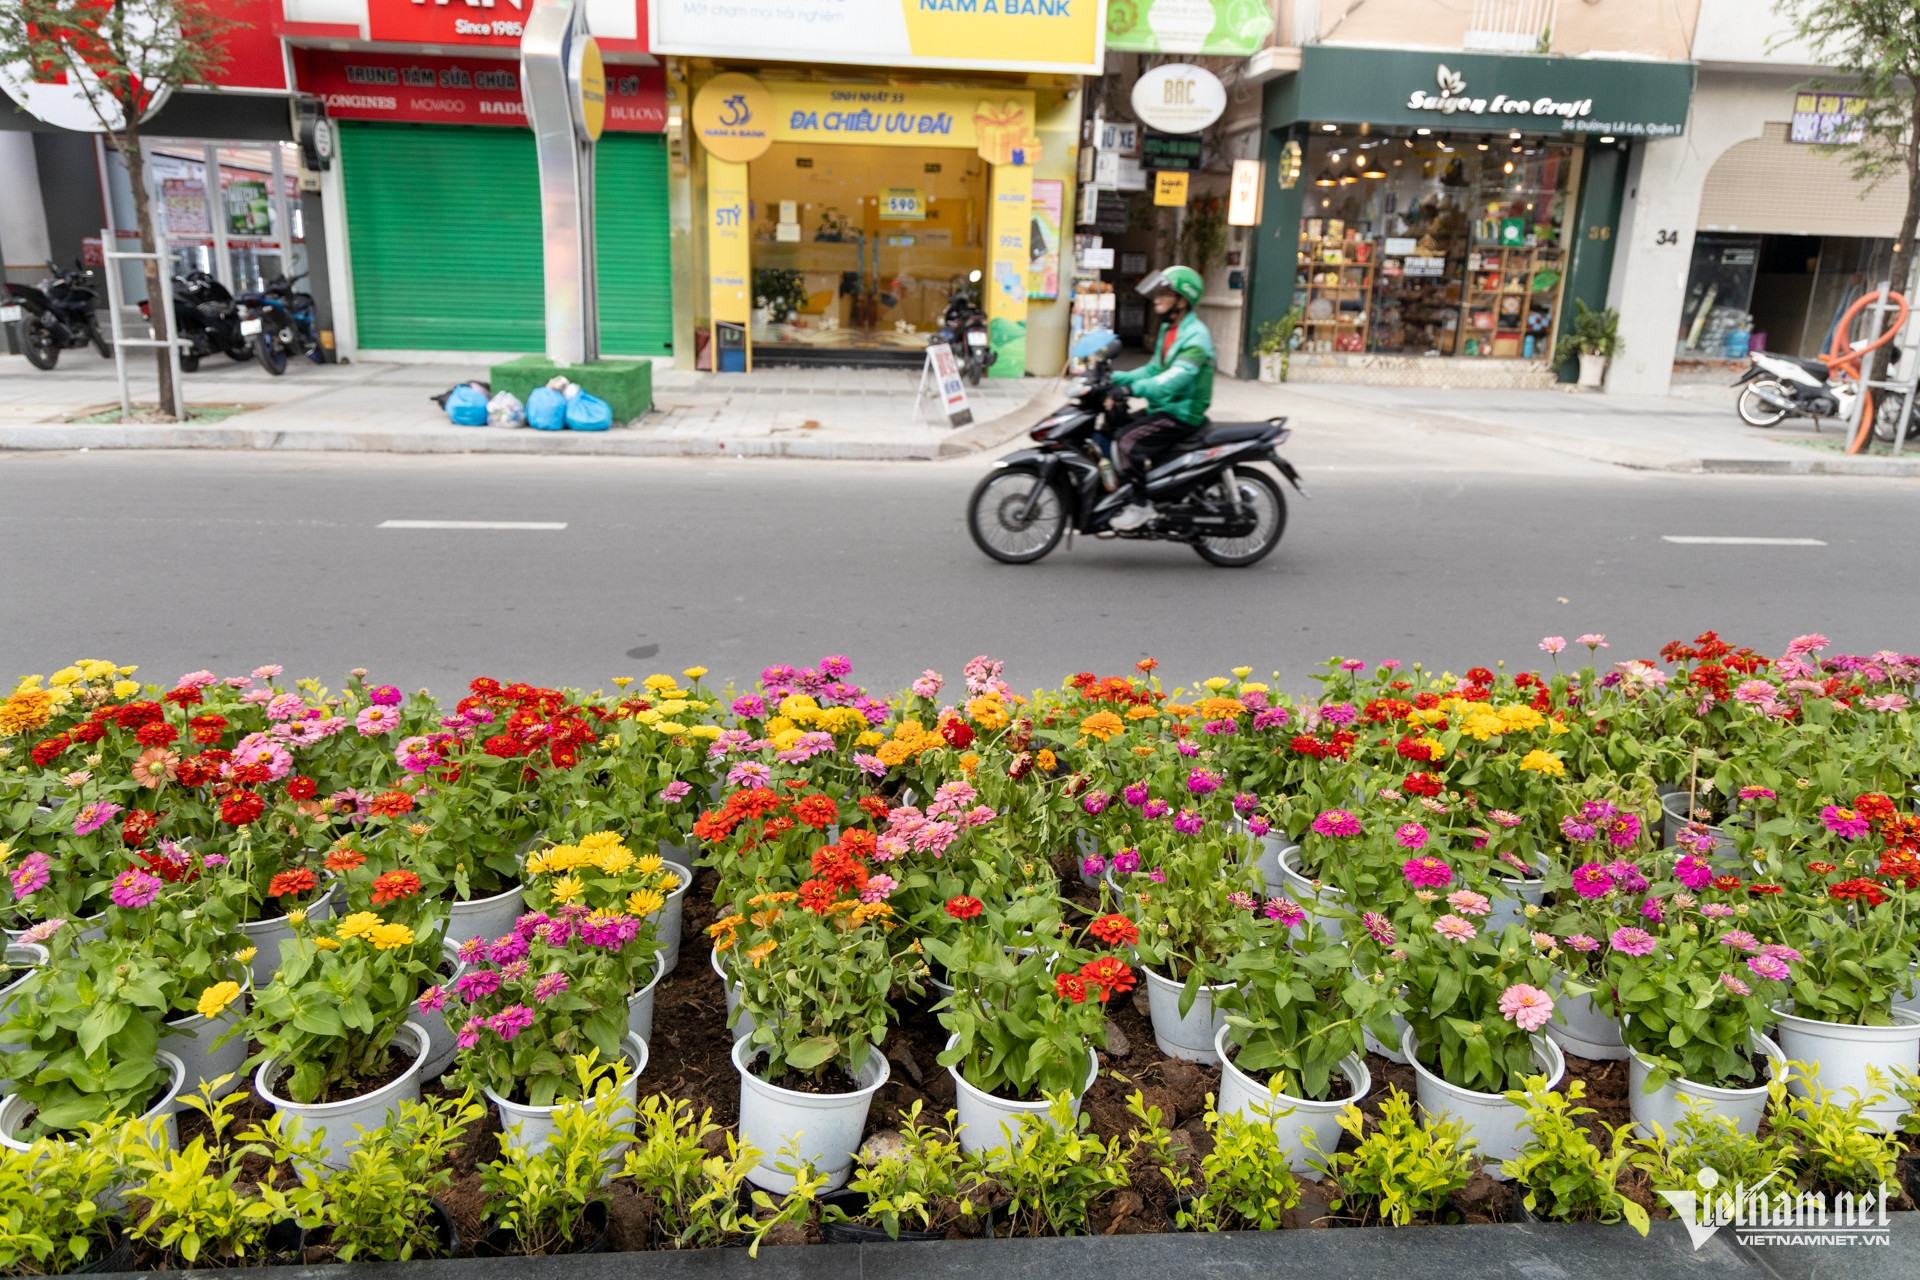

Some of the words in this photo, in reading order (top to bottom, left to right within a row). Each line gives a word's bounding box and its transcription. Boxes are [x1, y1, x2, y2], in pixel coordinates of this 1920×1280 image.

[920, 0, 977, 13] NAM
[983, 0, 998, 14] A
[1004, 0, 1071, 17] BANK
[455, 18, 491, 36] Since
[491, 20, 523, 37] 1985
[345, 64, 398, 86] TRUNG
[401, 64, 436, 88] TÂM
[830, 90, 857, 102] SINH
[325, 93, 397, 110] LONGINES
[410, 99, 466, 114] MOVADO
[610, 106, 664, 121] BULOVA
[1532, 97, 1593, 119] Craft
[789, 110, 819, 130] ĐA
[1562, 118, 1575, 131] 36
[1120, 131, 1135, 149] XE
[1588, 225, 1611, 241] 36
[1656, 228, 1678, 246] 34
